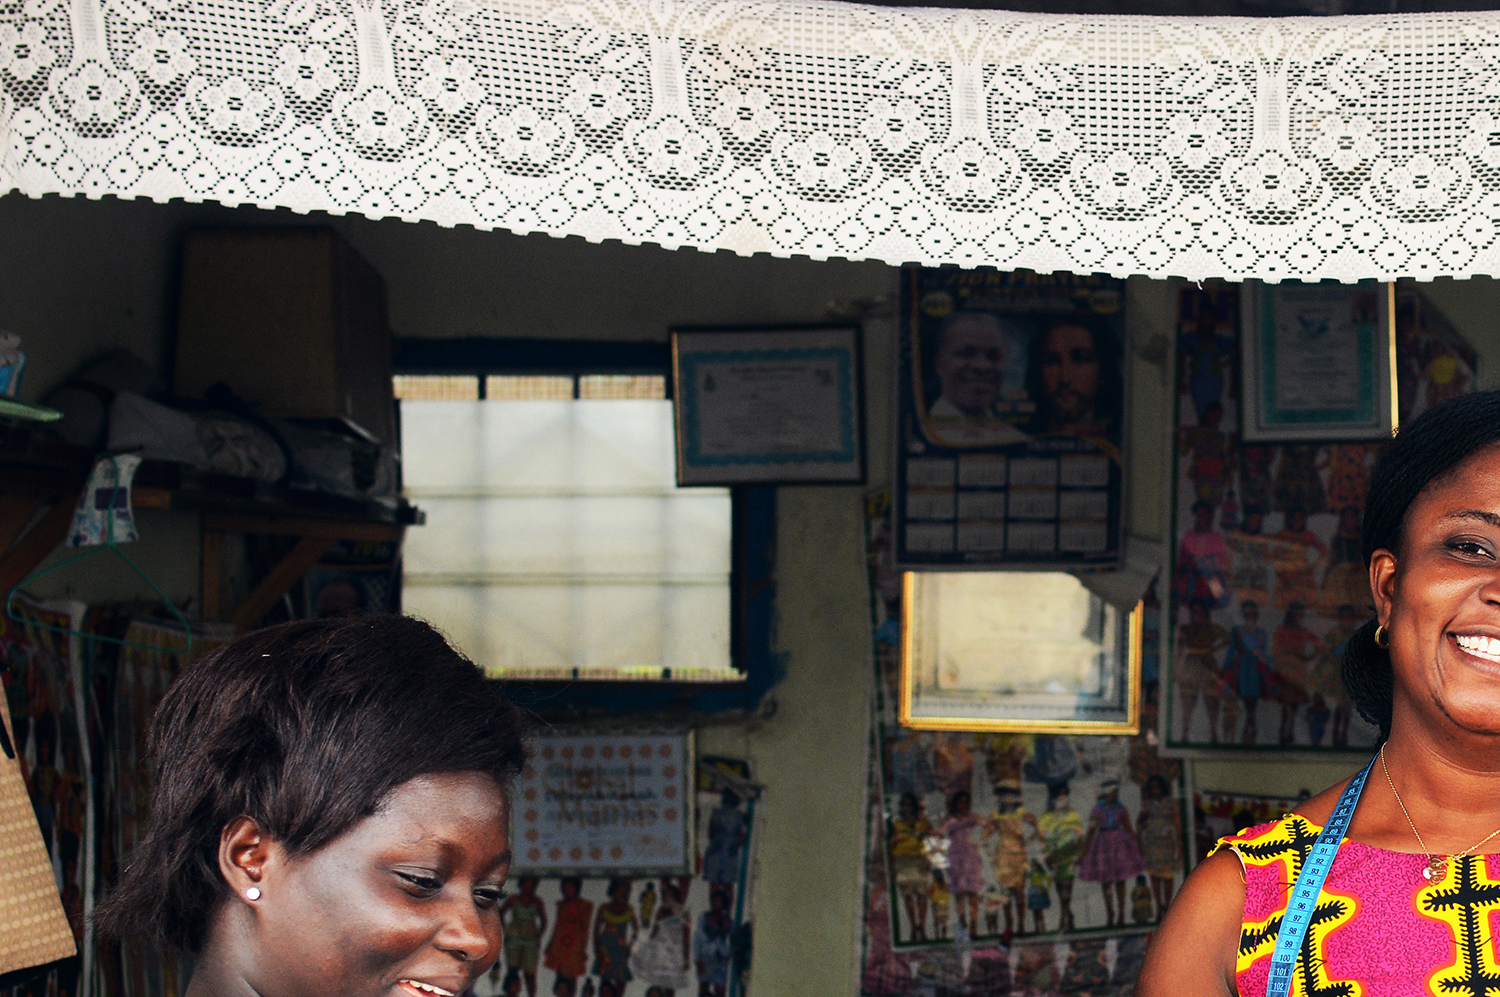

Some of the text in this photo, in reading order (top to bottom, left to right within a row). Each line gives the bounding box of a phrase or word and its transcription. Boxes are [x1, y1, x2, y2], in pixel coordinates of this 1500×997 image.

[543, 760, 635, 798] Global
[556, 799, 660, 831] Mamas
[1306, 878, 1315, 886] 94
[1301, 890, 1310, 898] 95
[1297, 902, 1306, 910] 96
[1293, 914, 1302, 922] 97
[1288, 927, 1298, 935] 98
[1284, 940, 1293, 948] 99
[1280, 954, 1291, 962] 100
[1276, 967, 1287, 976] 101
[1273, 982, 1284, 991] 102
